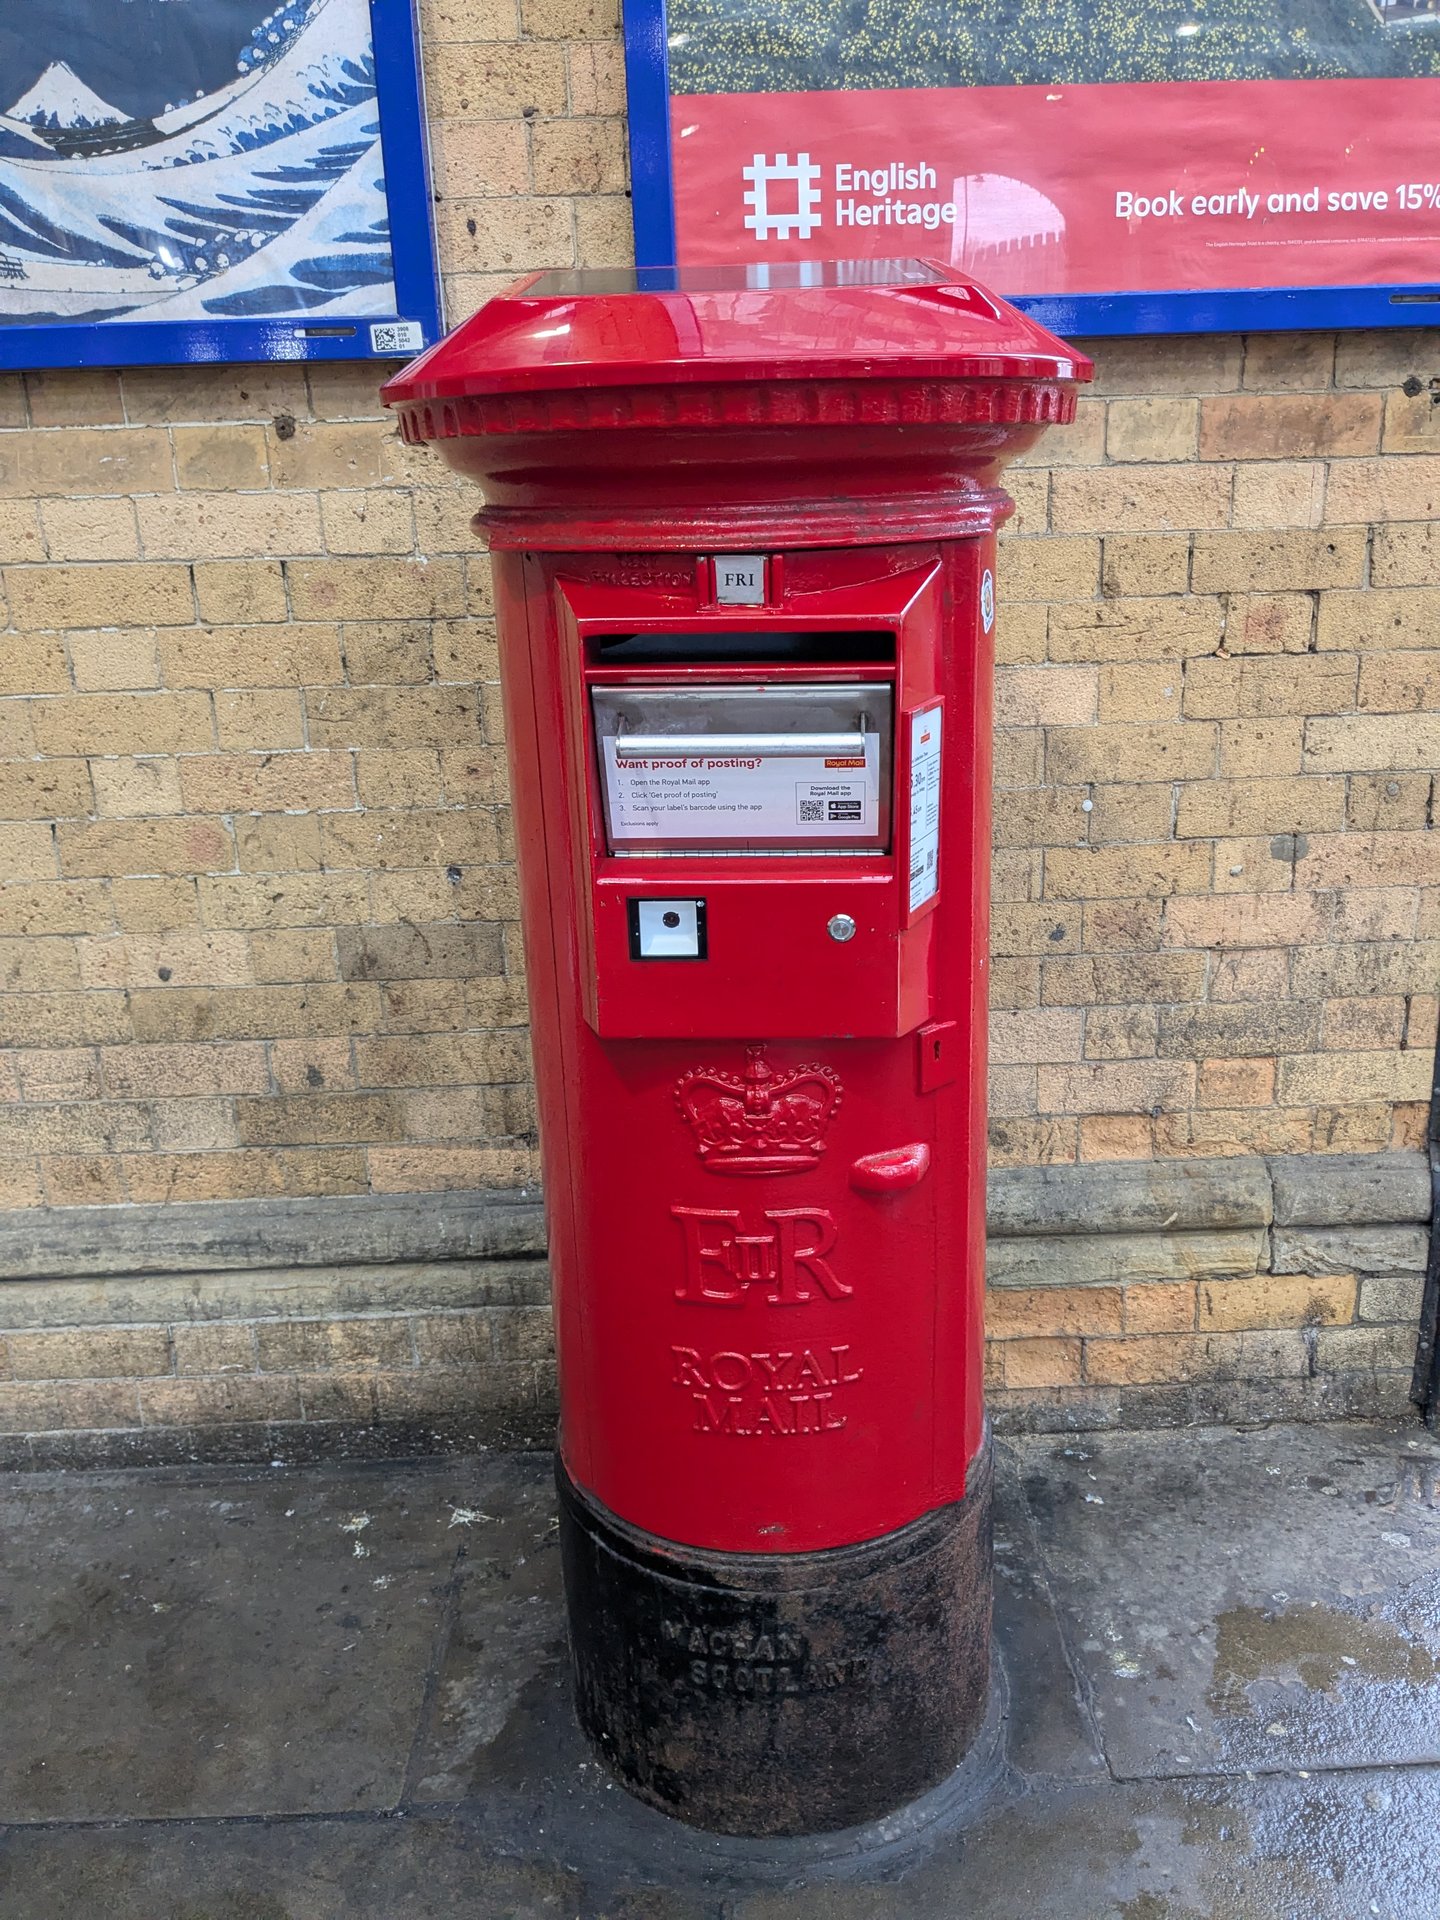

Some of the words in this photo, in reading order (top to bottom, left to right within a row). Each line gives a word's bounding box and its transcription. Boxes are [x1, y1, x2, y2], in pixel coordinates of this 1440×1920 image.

[836, 162, 936, 196] English
[836, 198, 958, 230] Heritage
[1115, 190, 1185, 218] Book
[1191, 187, 1259, 219] early
[1267, 186, 1319, 213] and
[1327, 190, 1388, 212] save
[1395, 183, 1440, 209] 15%
[724, 573, 755, 587] FRI
[615, 760, 648, 768] Want
[652, 759, 687, 770] proof
[691, 759, 704, 768] of
[707, 759, 762, 770] posting?
[662, 779, 680, 787] Royal
[670, 1345, 864, 1391] ROYAL
[692, 1391, 848, 1435] MAIL
